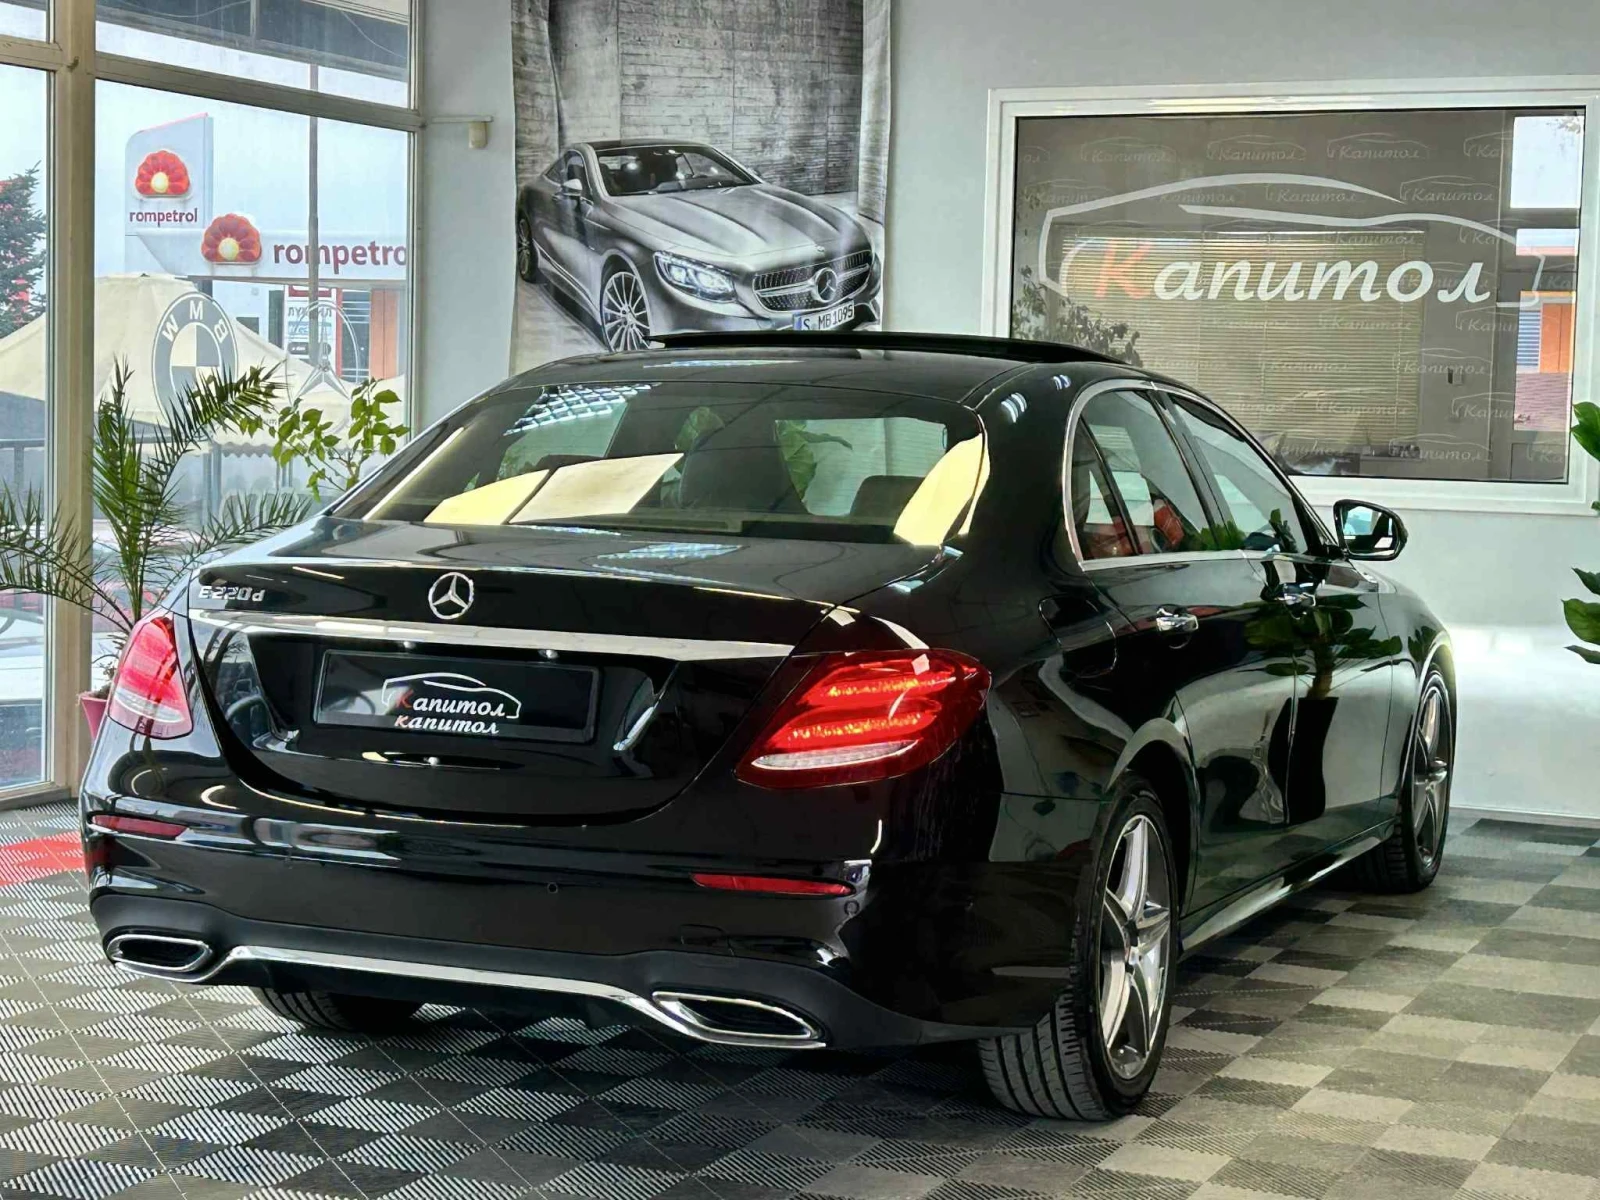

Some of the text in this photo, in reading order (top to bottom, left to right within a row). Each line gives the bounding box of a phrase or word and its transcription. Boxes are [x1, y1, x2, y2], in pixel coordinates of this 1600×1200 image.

[1338, 145, 1420, 159] Капитол
[1411, 188, 1493, 202] Капитол
[129, 208, 198, 227] rompetrol
[274, 240, 407, 275] rompetro
[1093, 240, 1490, 303] Капитол
[803, 318, 811, 330] S
[396, 689, 506, 717] Капитол
